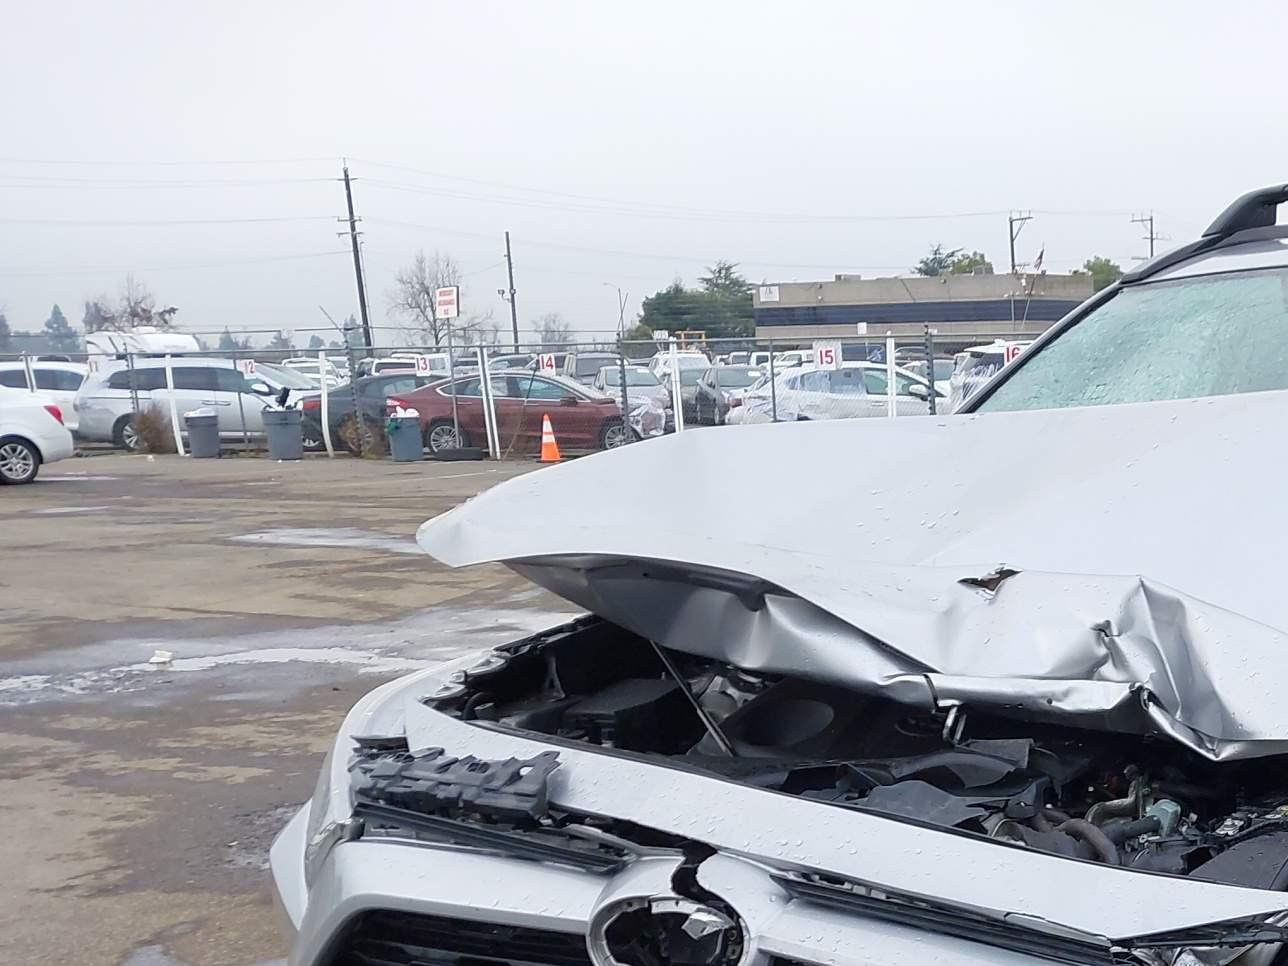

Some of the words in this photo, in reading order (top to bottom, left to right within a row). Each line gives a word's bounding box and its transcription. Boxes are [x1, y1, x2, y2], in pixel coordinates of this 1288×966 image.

[416, 357, 428, 371] 13
[540, 354, 554, 369] 14
[819, 349, 834, 365] 15
[244, 360, 255, 374] 12
